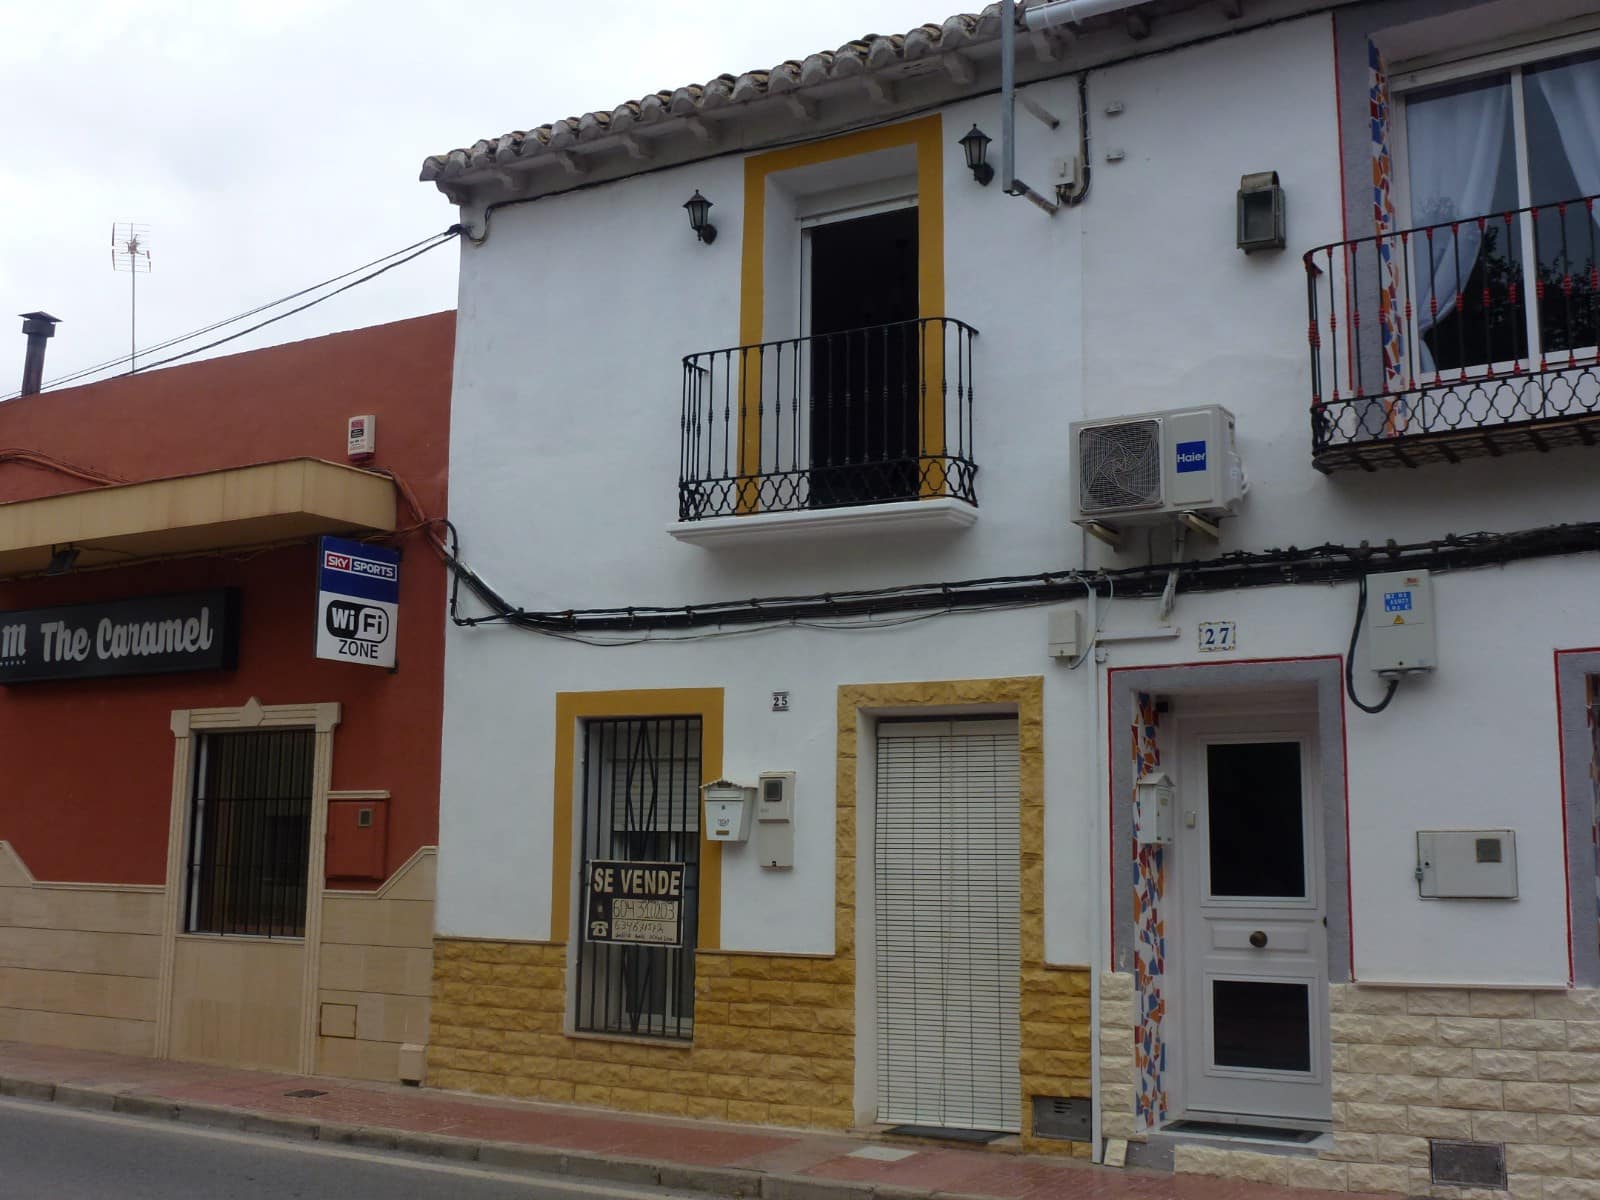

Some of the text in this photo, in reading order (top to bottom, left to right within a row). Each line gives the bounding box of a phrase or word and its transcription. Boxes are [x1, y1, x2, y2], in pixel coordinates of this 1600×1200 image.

[1177, 451, 1206, 463] Haier
[328, 555, 393, 577] SKY SPORTS
[40, 620, 91, 662] The
[96, 606, 213, 660] Caramel
[1205, 627, 1230, 645] 27
[338, 640, 379, 659] ZONE
[773, 696, 788, 706] 25
[593, 867, 681, 896] SE VENDE
